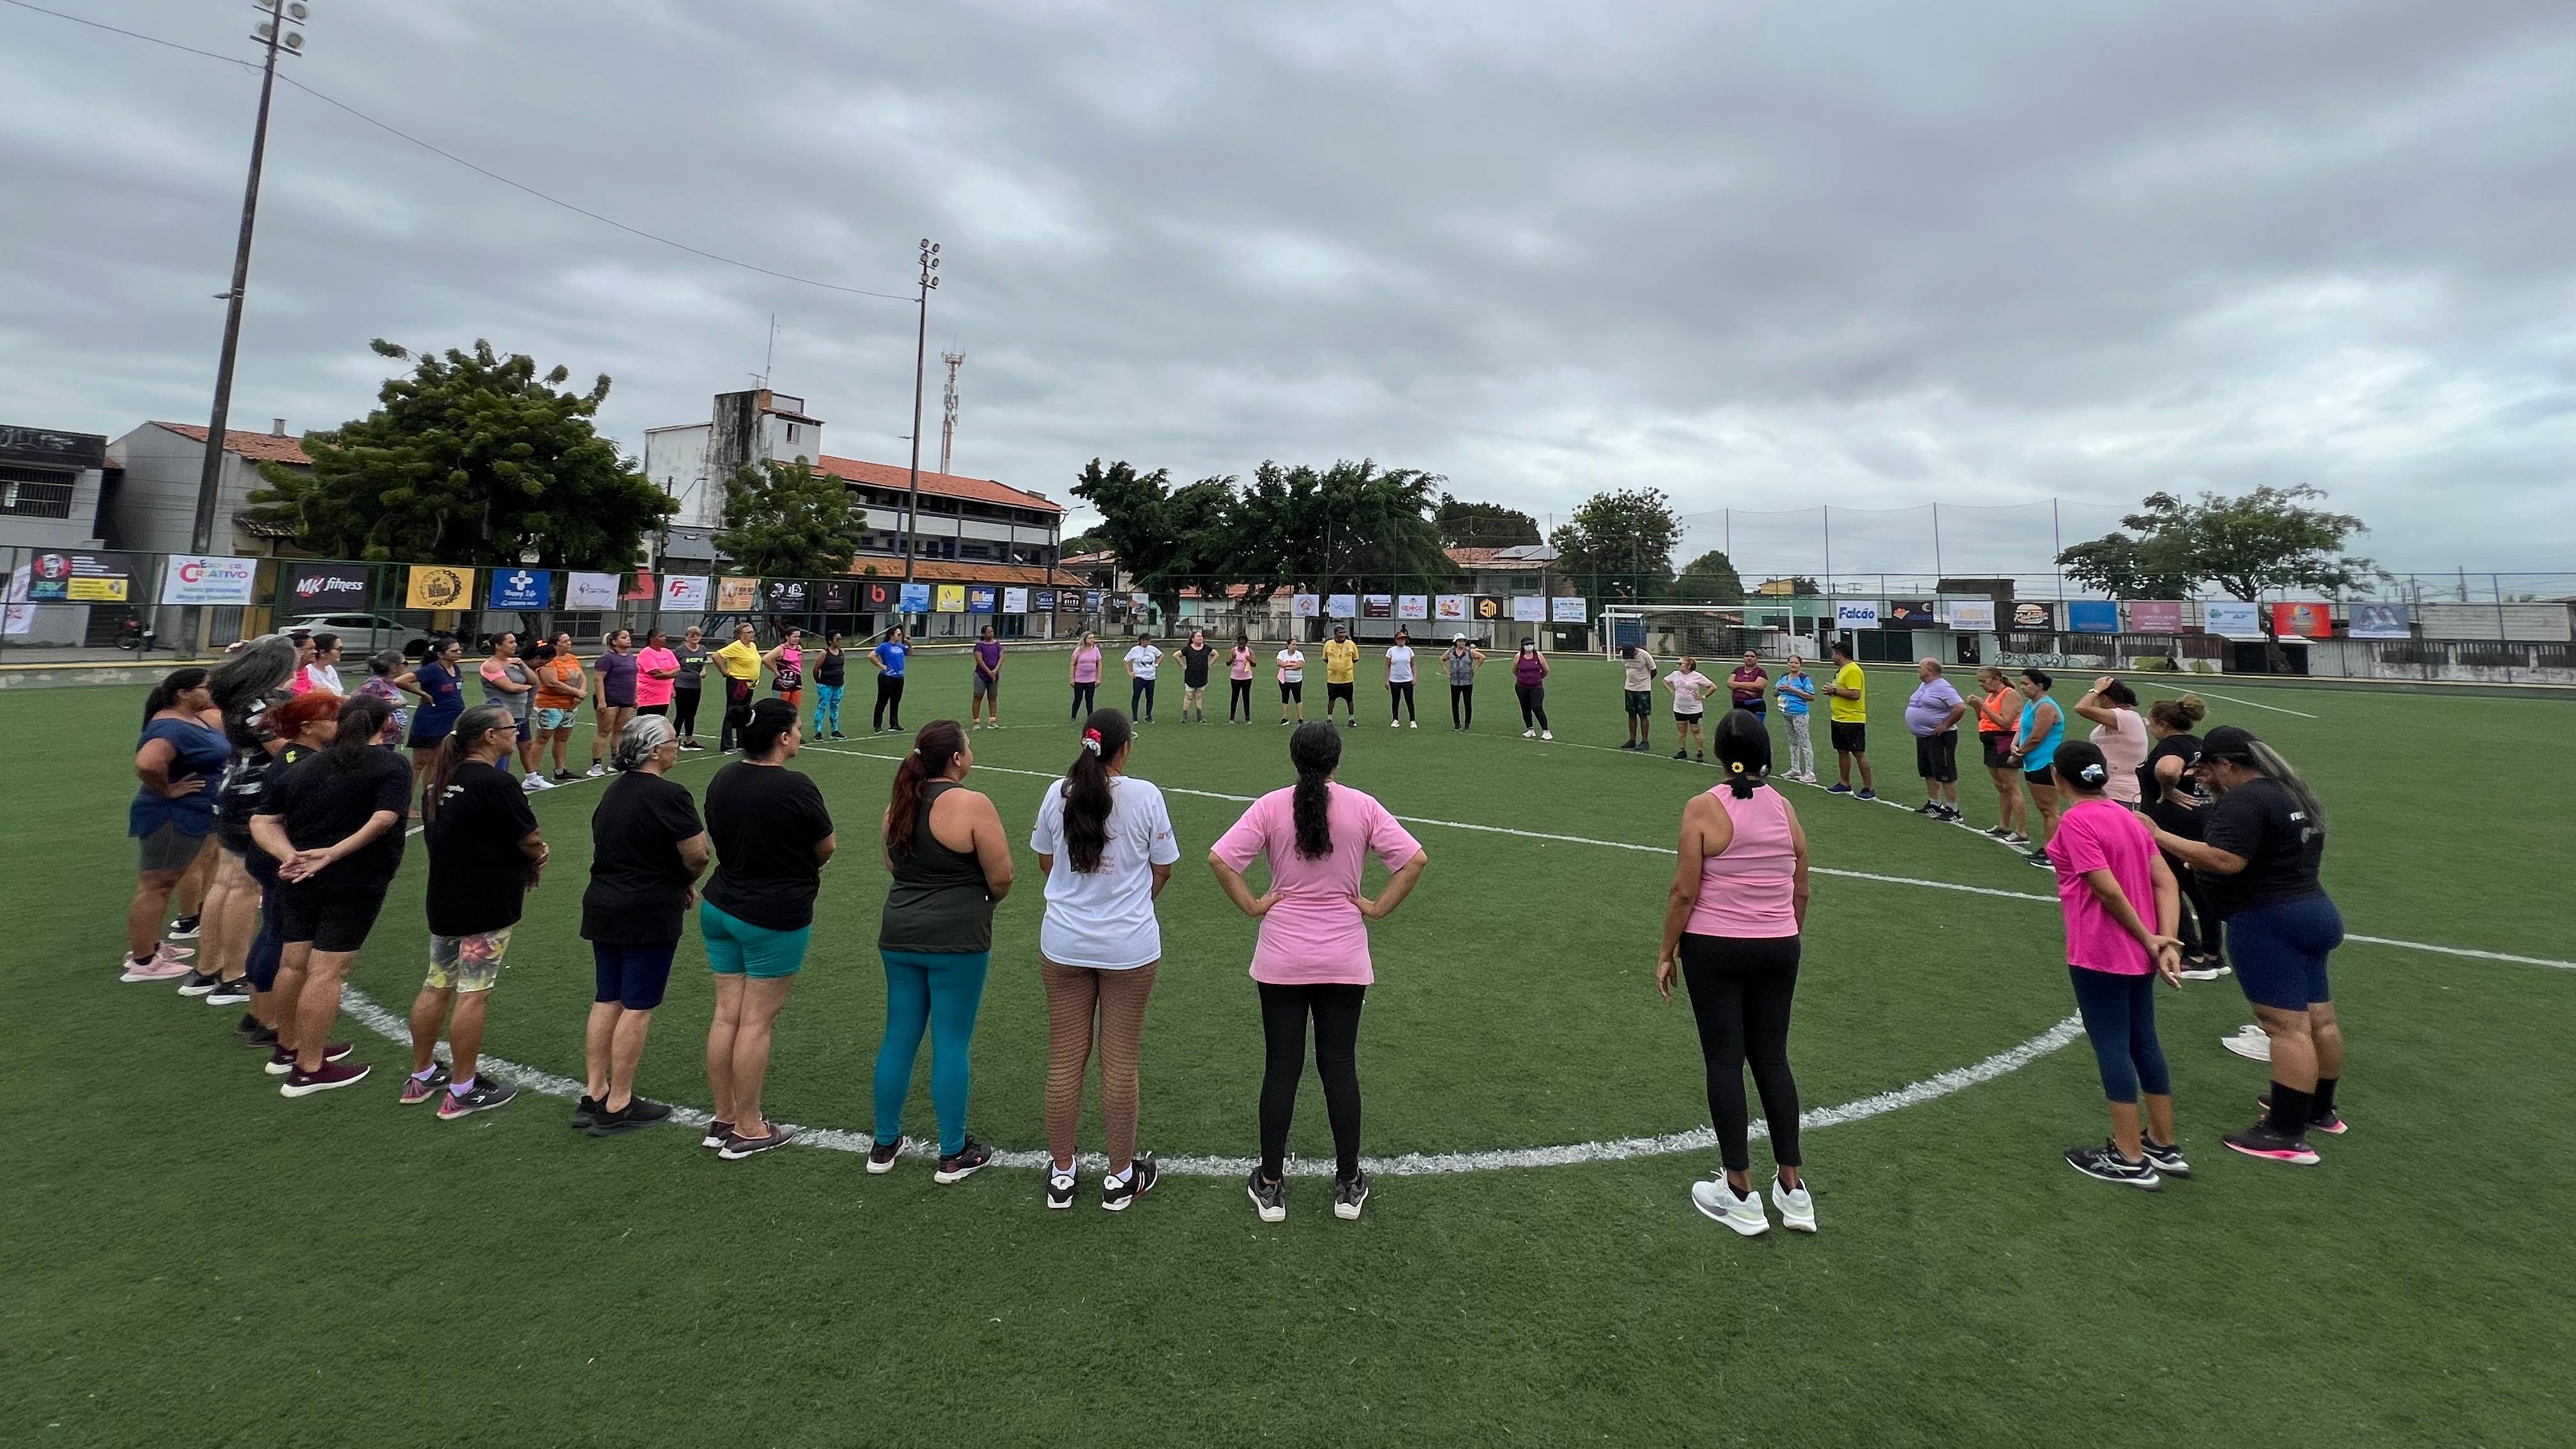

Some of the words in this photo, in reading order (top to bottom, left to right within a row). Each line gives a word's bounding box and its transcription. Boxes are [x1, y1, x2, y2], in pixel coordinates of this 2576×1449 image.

[296, 578, 325, 594] MK
[323, 577, 364, 592] fitness
[1839, 607, 1875, 619] Falcão
